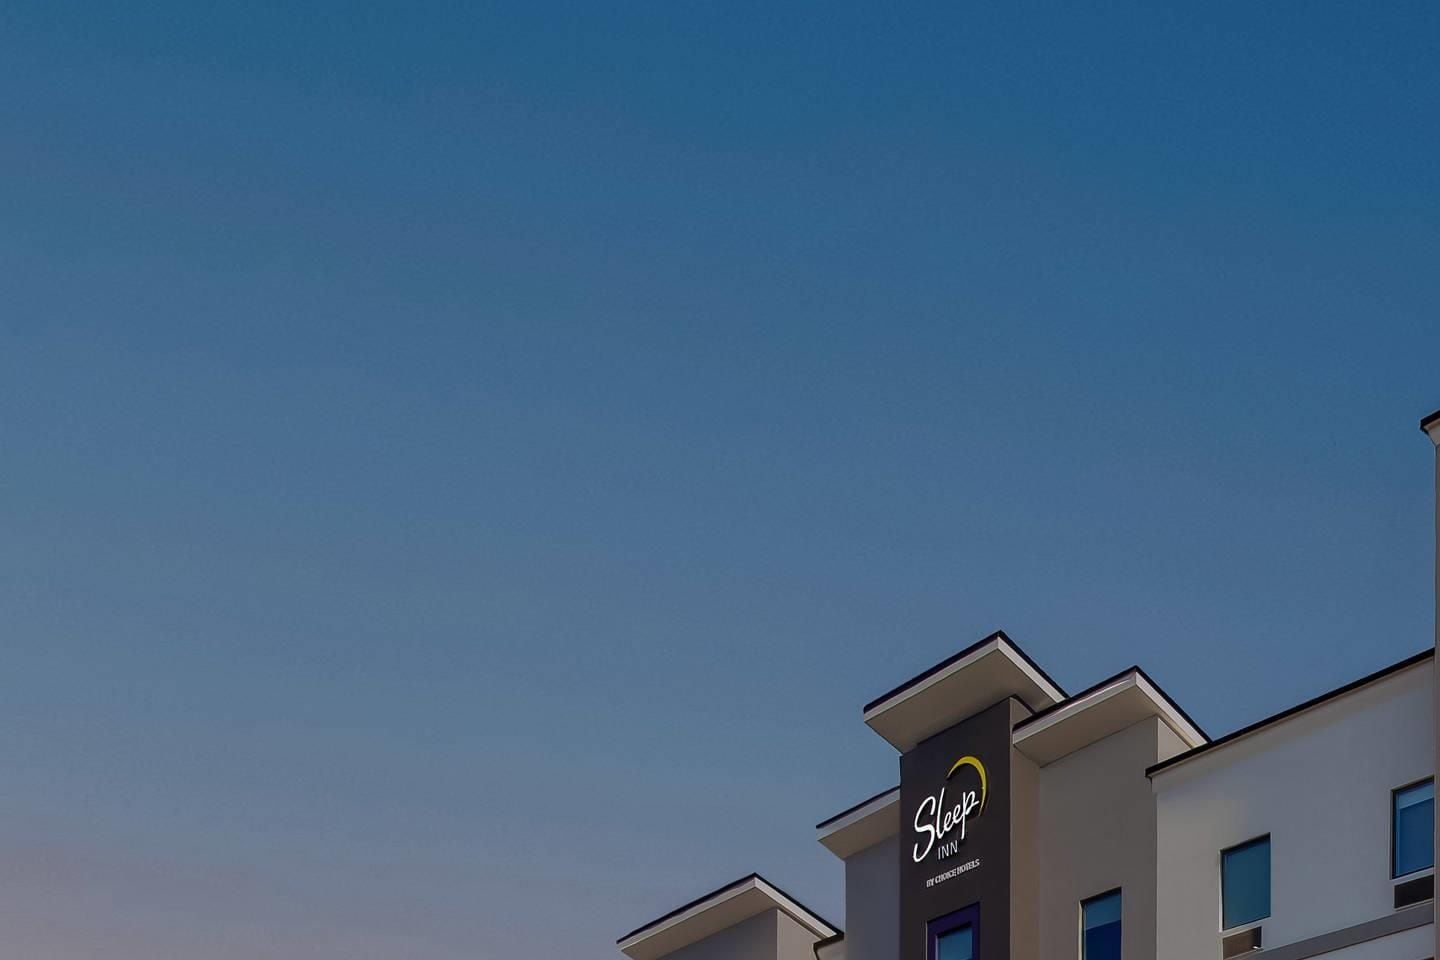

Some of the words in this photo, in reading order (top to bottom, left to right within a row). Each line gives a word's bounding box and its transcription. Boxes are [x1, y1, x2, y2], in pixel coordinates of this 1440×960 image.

[913, 786, 980, 863] Sleep
[938, 840, 958, 860] INN
[935, 868, 957, 884] CHOICE
[957, 858, 980, 875] HOTELS
